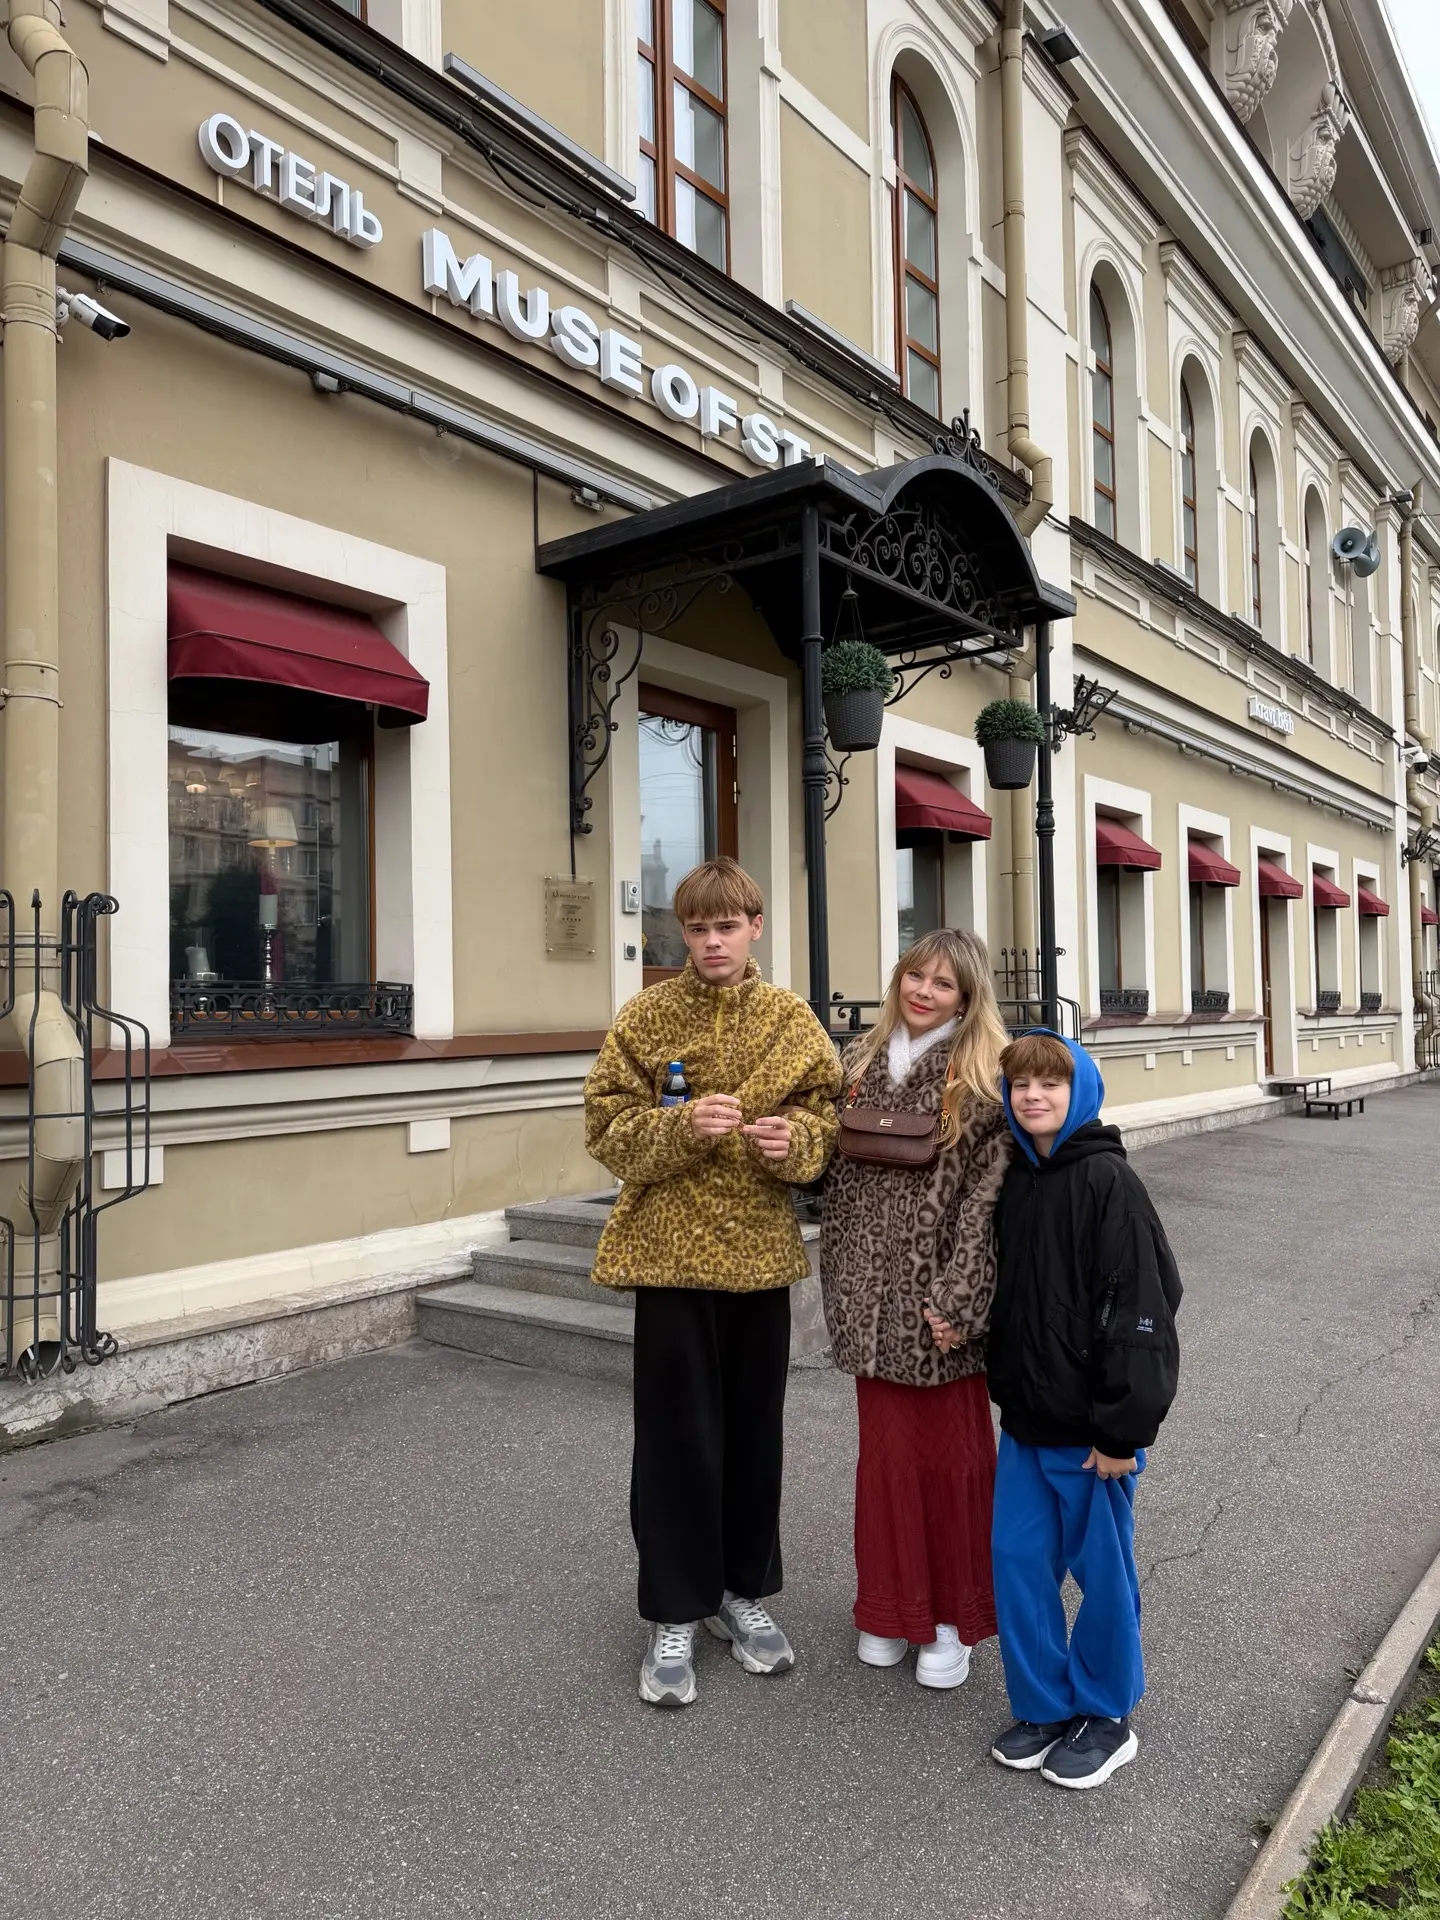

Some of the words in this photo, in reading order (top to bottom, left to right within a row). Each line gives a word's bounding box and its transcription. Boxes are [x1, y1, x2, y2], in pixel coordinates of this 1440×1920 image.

[198, 112, 383, 249] ОТЕЛЬ
[422, 227, 643, 398] MUSE
[651, 363, 738, 440] OF
[741, 412, 832, 468] ST
